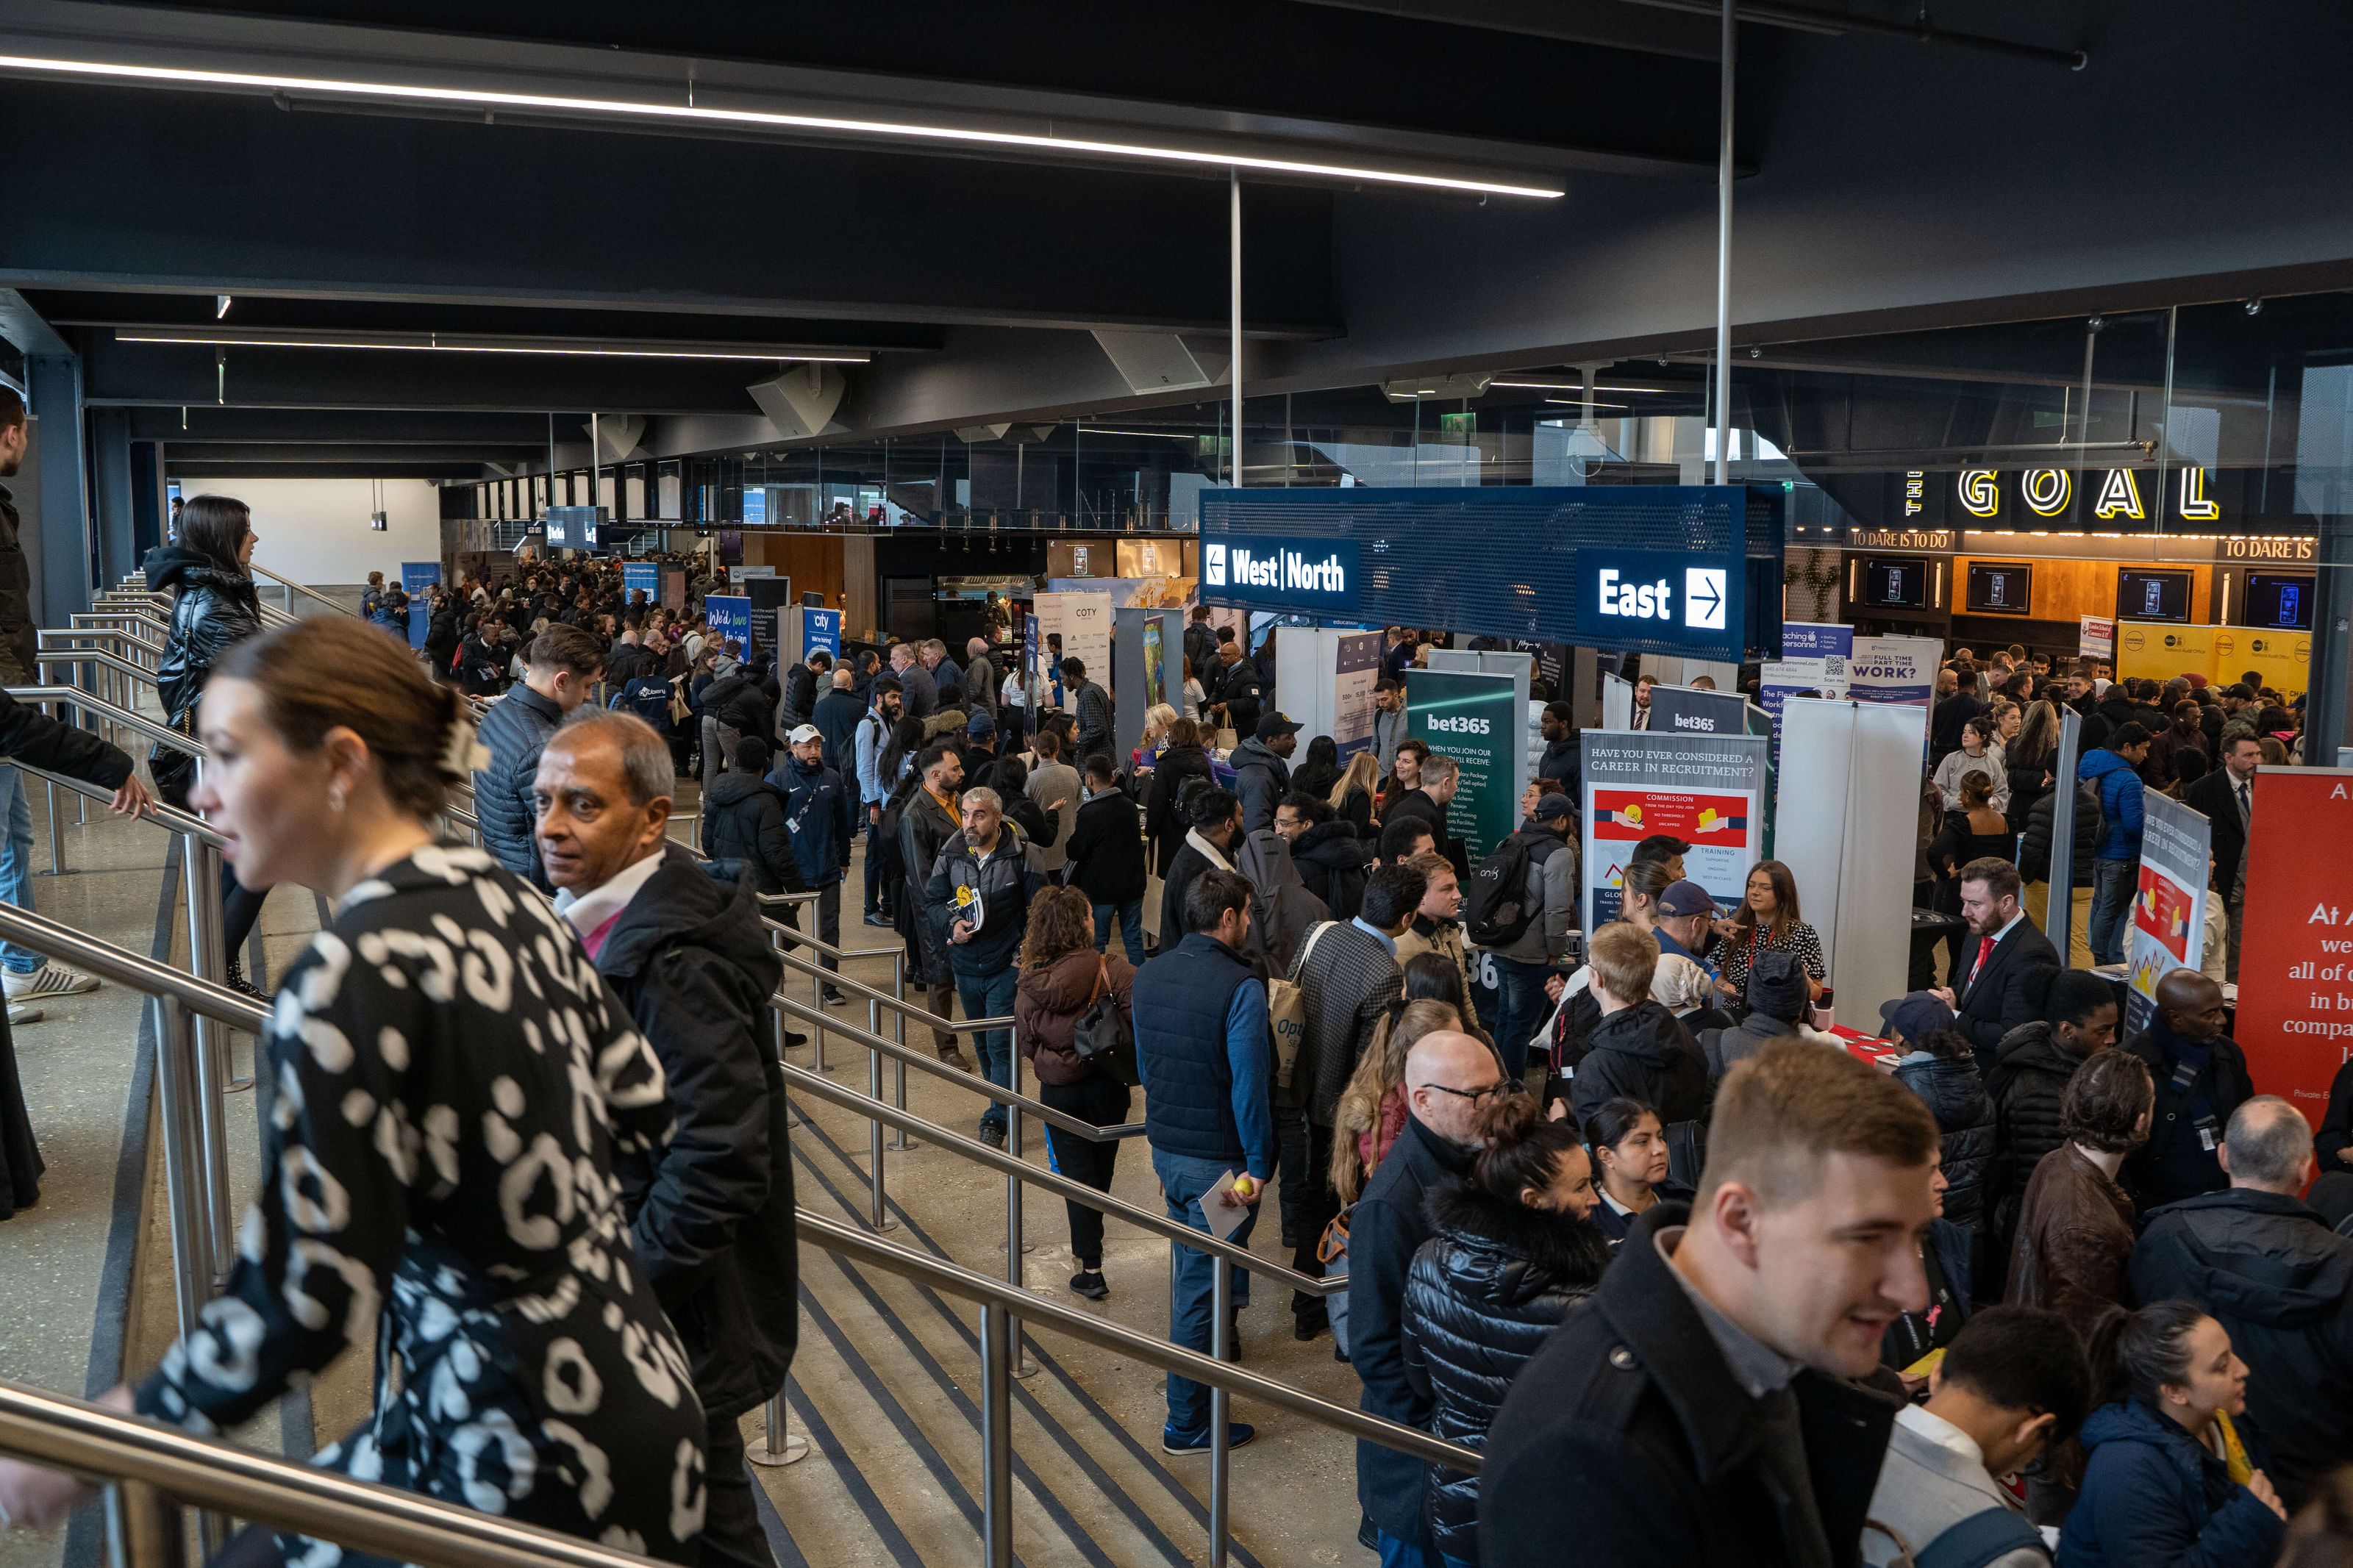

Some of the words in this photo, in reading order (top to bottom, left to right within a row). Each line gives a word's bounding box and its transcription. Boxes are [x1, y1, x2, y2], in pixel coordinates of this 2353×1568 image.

[1958, 468, 2219, 520] GOAL
[1852, 532, 1866, 546] TO
[1868, 532, 1897, 547] DARE
[1900, 533, 1910, 547] IS
[1913, 534, 1927, 548] TO
[1929, 534, 1947, 548] DO
[2225, 540, 2245, 557] TO
[2249, 541, 2293, 559] DARE
[2296, 542, 2312, 559] IS
[1232, 549, 1278, 587] West
[1287, 552, 1344, 592] North
[1599, 568, 1671, 620] East
[732, 612, 747, 627] love
[1076, 608, 1097, 617] COTY
[814, 613, 829, 631] city
[1782, 632, 1807, 642] aching
[1853, 666, 1916, 679] WORK?
[1428, 713, 1490, 735] bet365
[1675, 713, 1715, 732] bet365
[1461, 747, 1477, 755] JOIN
[1591, 748, 1619, 758] HAVE
[1621, 750, 1643, 759] YOU
[1646, 751, 1672, 760] EVER
[1675, 752, 1743, 763] CONSIDERED
[1746, 755, 1754, 764] A
[1466, 757, 1490, 766] RECEIVE:
[1591, 761, 1640, 772] CAREER
[1645, 763, 1657, 772] IN
[1662, 763, 1754, 777] RECRUITMENT?
[1646, 794, 1693, 803] COMMISSION
[1460, 812, 1477, 820] Training
[2145, 814, 2156, 826] AVE
[2163, 822, 2175, 837] EVER
[1701, 848, 1735, 856] TRAINING
[2143, 828, 2160, 847] AREER
[2160, 838, 2168, 851] IN
[2168, 842, 2200, 871] RECRUITMENT?
[2307, 902, 2339, 925] At
[2321, 939, 2352, 953] we
[2288, 962, 2315, 979] all
[2321, 963, 2345, 981] of
[2310, 992, 2330, 1009] in
[2283, 1020, 2353, 1039] compa
[2294, 1089, 2321, 1099] Private
